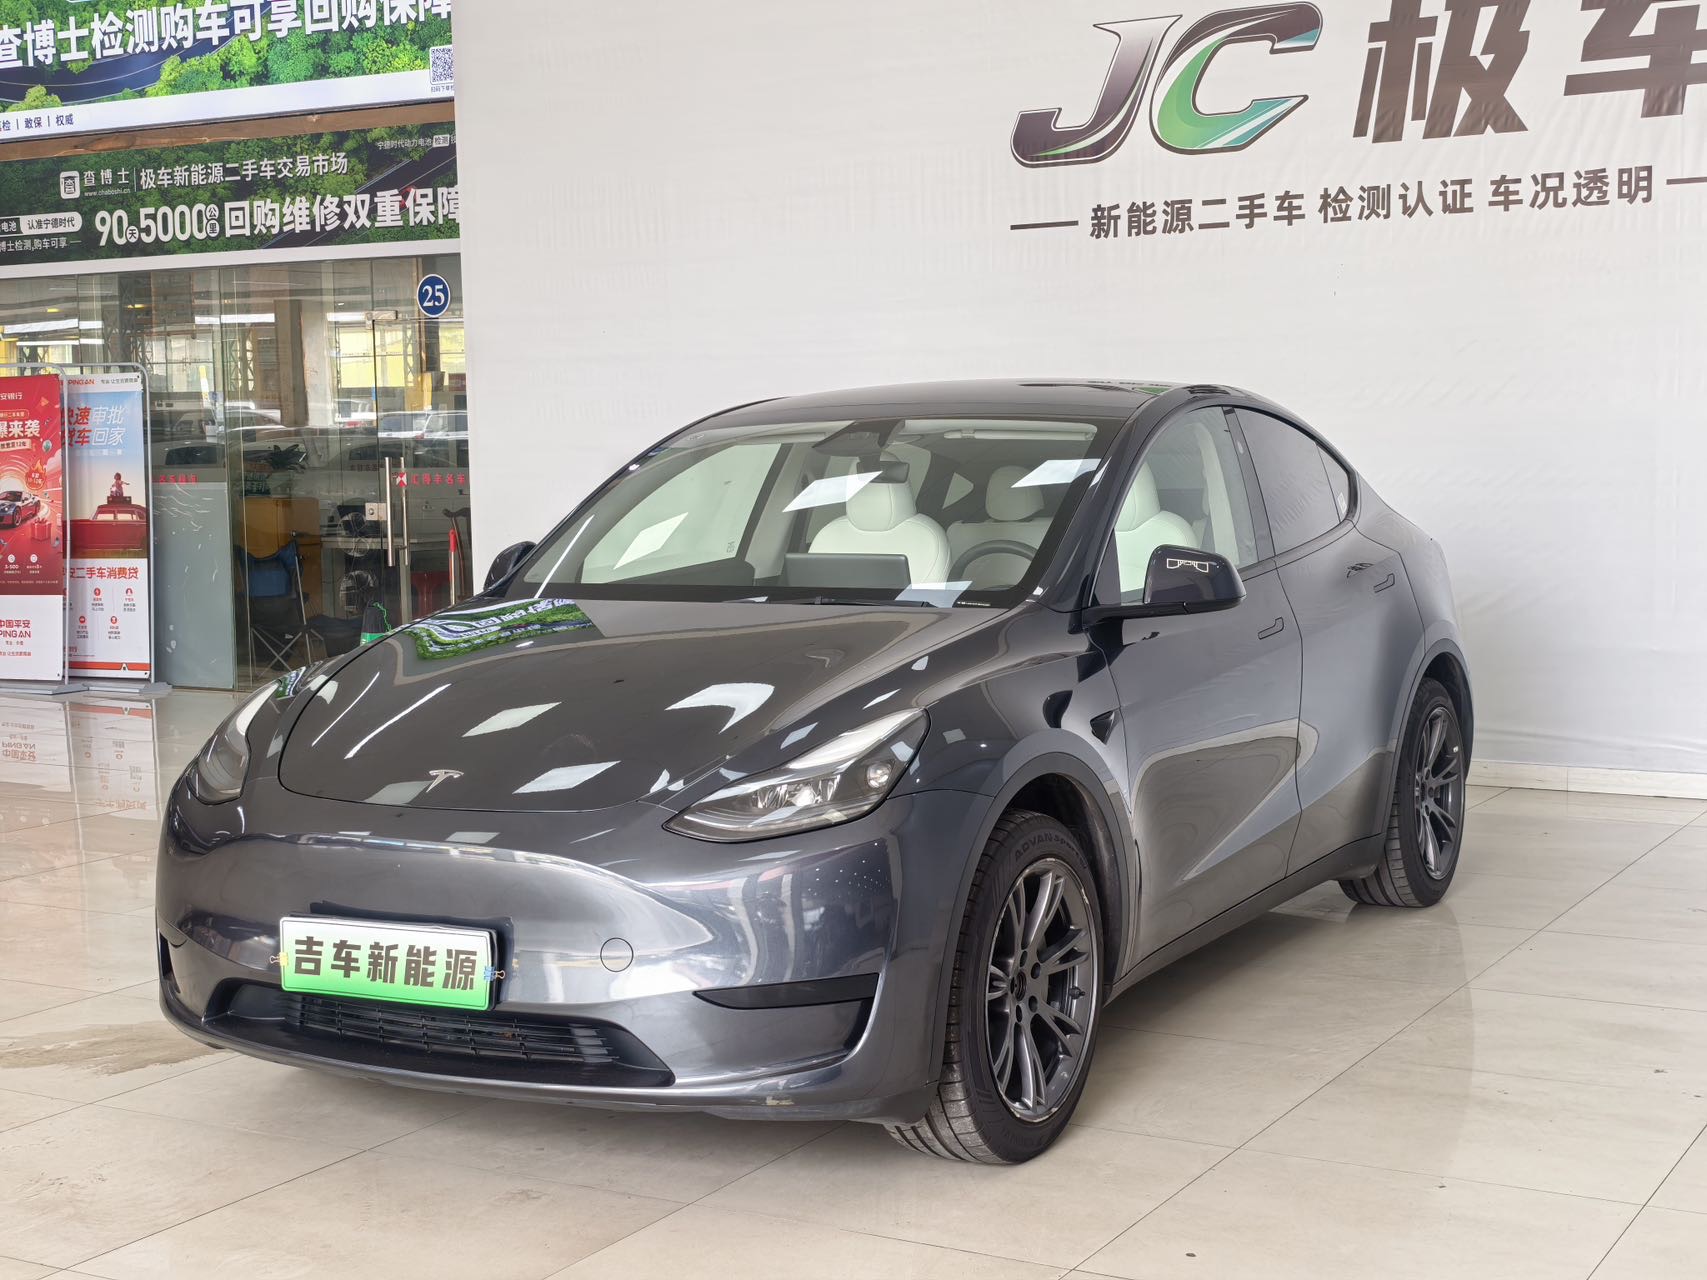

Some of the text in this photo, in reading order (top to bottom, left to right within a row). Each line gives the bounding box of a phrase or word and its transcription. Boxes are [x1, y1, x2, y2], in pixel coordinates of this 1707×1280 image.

[1353, 0, 1707, 143] 极车
[1009, 1, 1323, 168] JC
[0, 119, 11, 131] 检
[56, 113, 74, 126] 权威
[83, 168, 130, 187] 查博士
[140, 152, 348, 190] 极车新能源二手车交易市场
[1090, 165, 1653, 239] 新能源二手车 检测认证 车况透明
[27, 217, 75, 230] 认准宁德时代
[422, 284, 445, 307] 25
[62, 566, 139, 579] 安二手车消费贷
[0, 620, 31, 628] 中国平安
[294, 936, 478, 990] 吉车新能源
